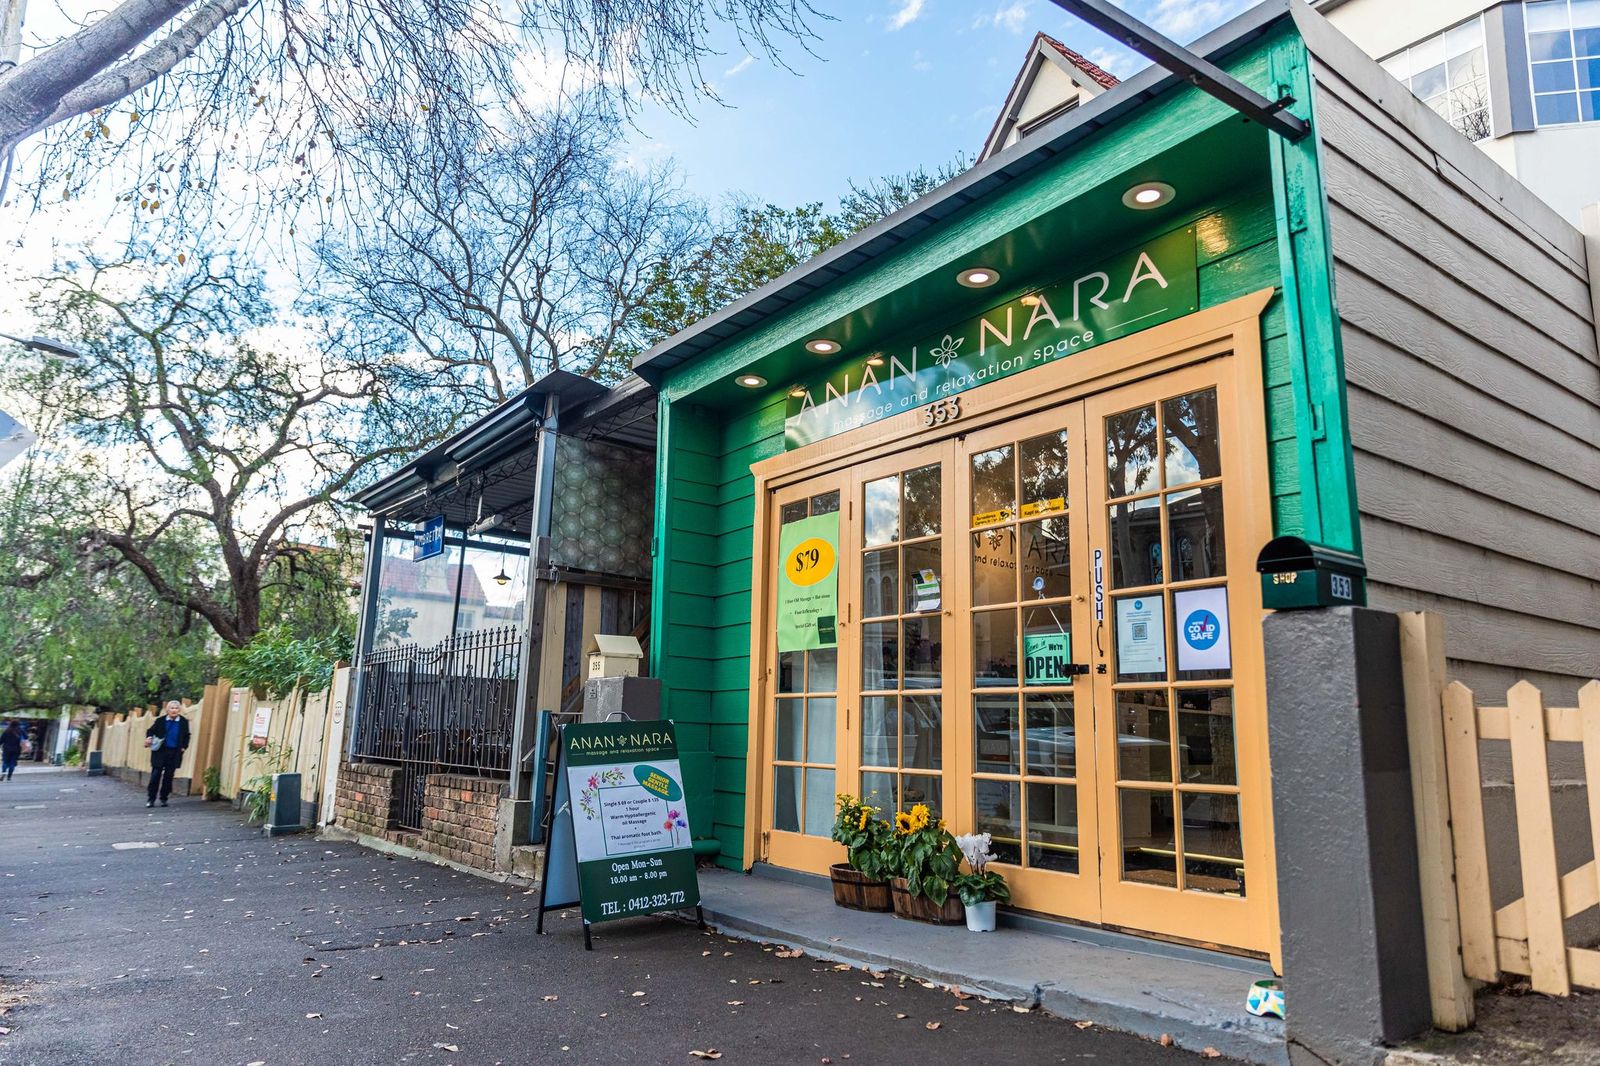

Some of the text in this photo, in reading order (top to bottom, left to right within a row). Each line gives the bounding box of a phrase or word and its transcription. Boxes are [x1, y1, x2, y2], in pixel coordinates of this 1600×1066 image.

[796, 252, 1169, 425] ANAN NARA
[833, 330, 1094, 432] massage and relaxation space
[923, 397, 960, 426] 353
[796, 548, 820, 573] $79
[1094, 549, 1104, 620] PUSH
[1272, 572, 1297, 584] SHOP
[1332, 576, 1351, 598] 353
[1188, 624, 1216, 633] COVID
[1190, 632, 1214, 641] SAFE
[1025, 656, 1064, 679] OPEN
[570, 732, 673, 750] ANAN NARA
[611, 858, 662, 873] Open Mon-Sun
[610, 875, 628, 884] 10.00
[644, 871, 657, 880] 8.00
[658, 870, 667, 879] pm
[600, 901, 620, 915] TEL
[628, 890, 685, 911] 0412-323-772
